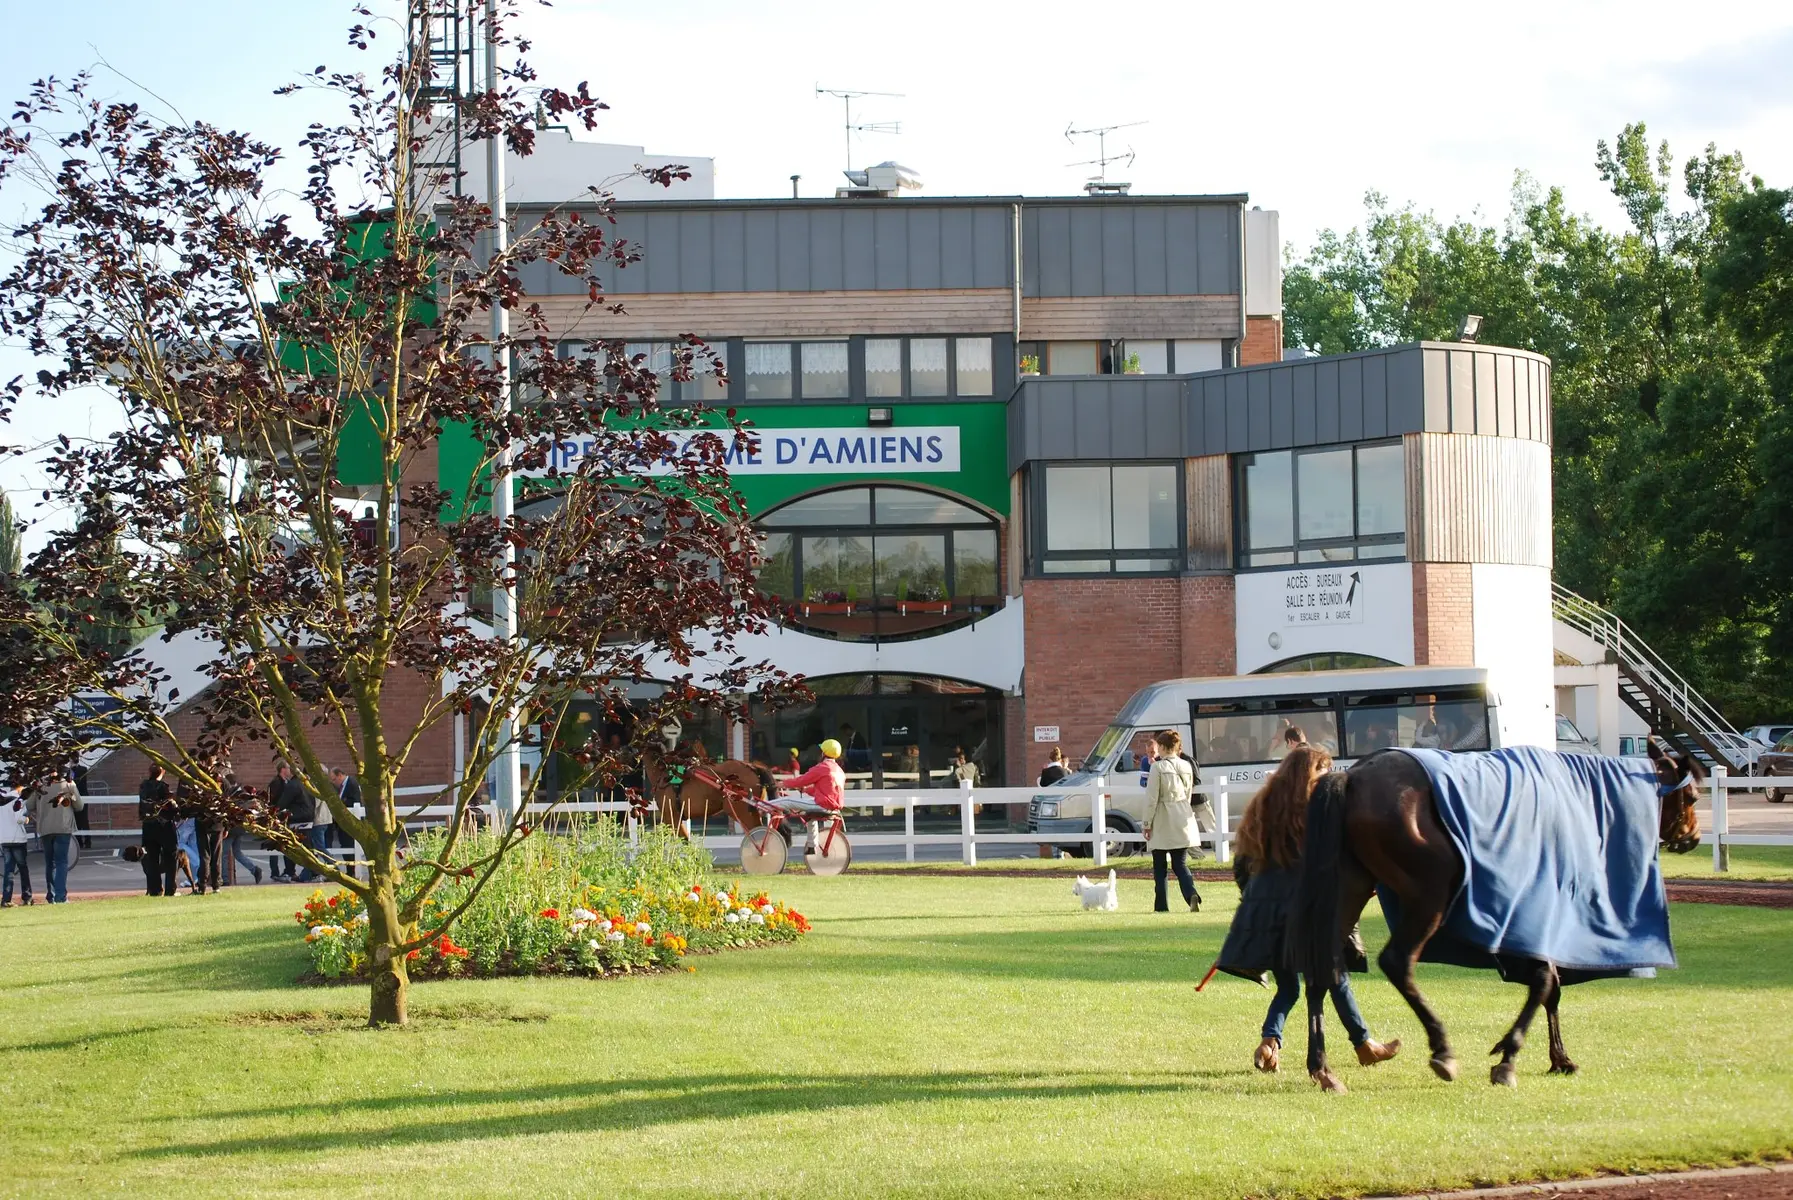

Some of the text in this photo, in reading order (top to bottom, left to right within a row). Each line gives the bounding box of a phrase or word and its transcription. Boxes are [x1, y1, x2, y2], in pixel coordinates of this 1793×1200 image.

[776, 436, 943, 465] D'AMIENS
[1316, 573, 1343, 588] BUREAUX
[1286, 589, 1343, 608] SALLE DE RÉUNION
[1229, 771, 1249, 781] LES
